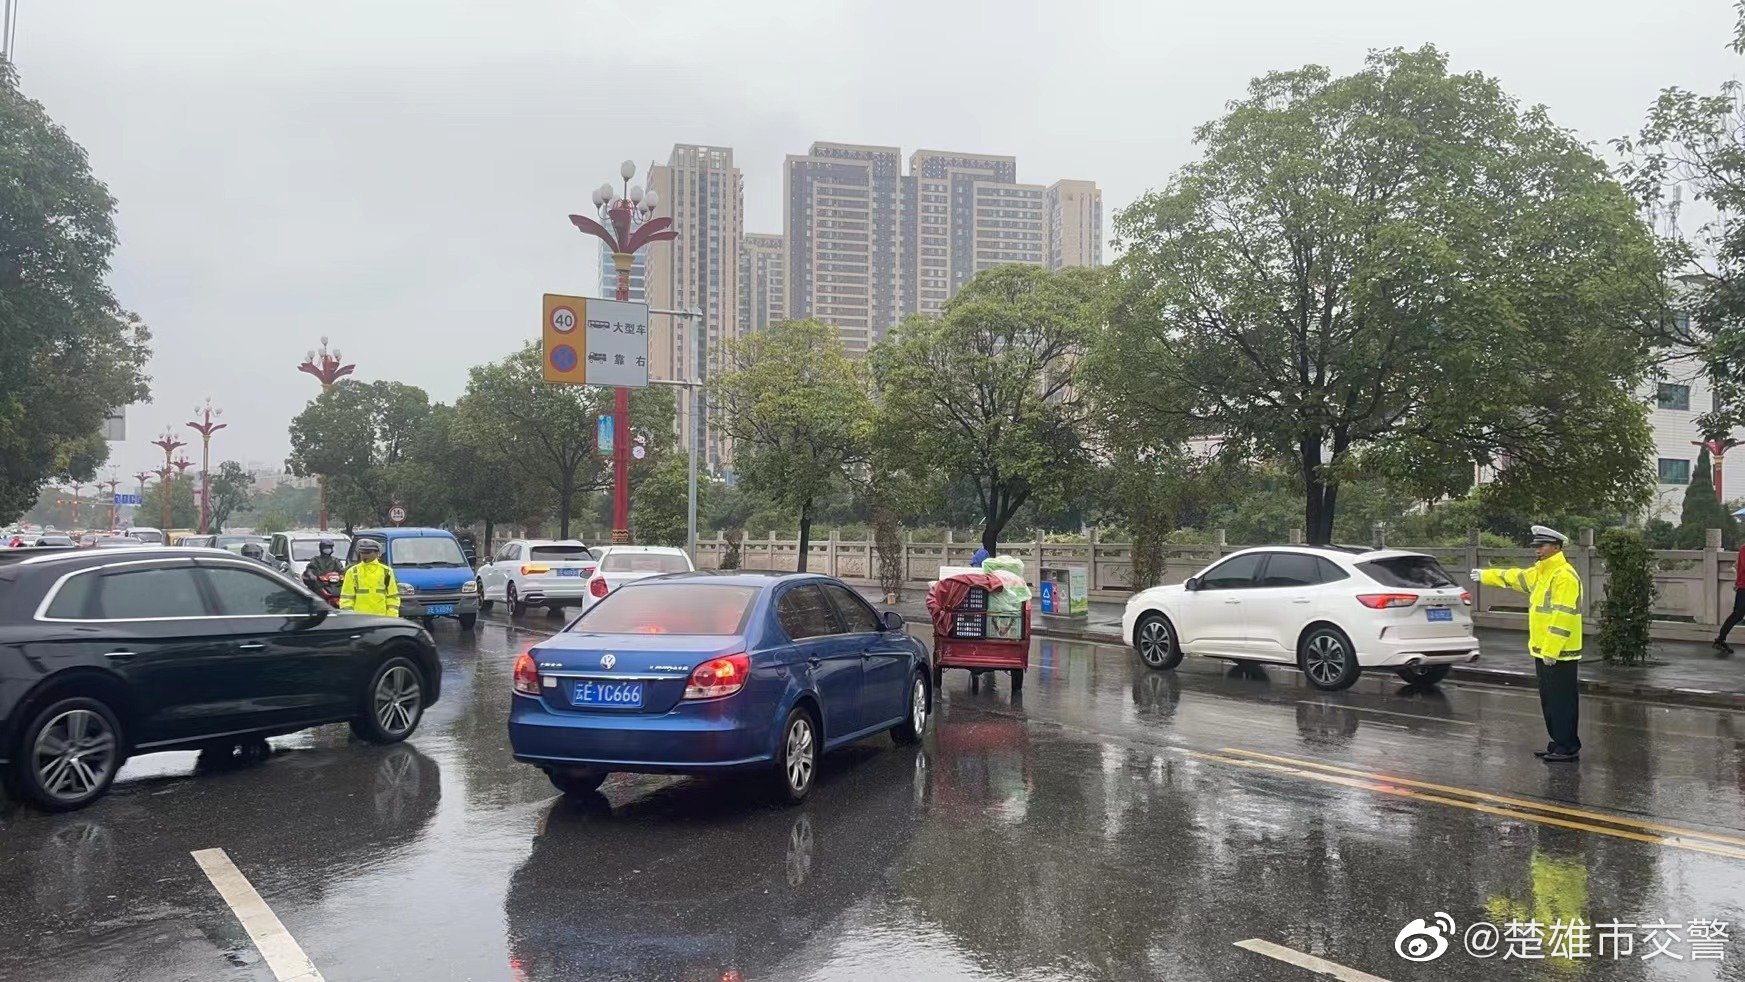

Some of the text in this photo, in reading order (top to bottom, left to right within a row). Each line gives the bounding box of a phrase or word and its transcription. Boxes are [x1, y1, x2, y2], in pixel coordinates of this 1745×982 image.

[555, 314, 573, 327] 40
[612, 323, 647, 336] 大型车
